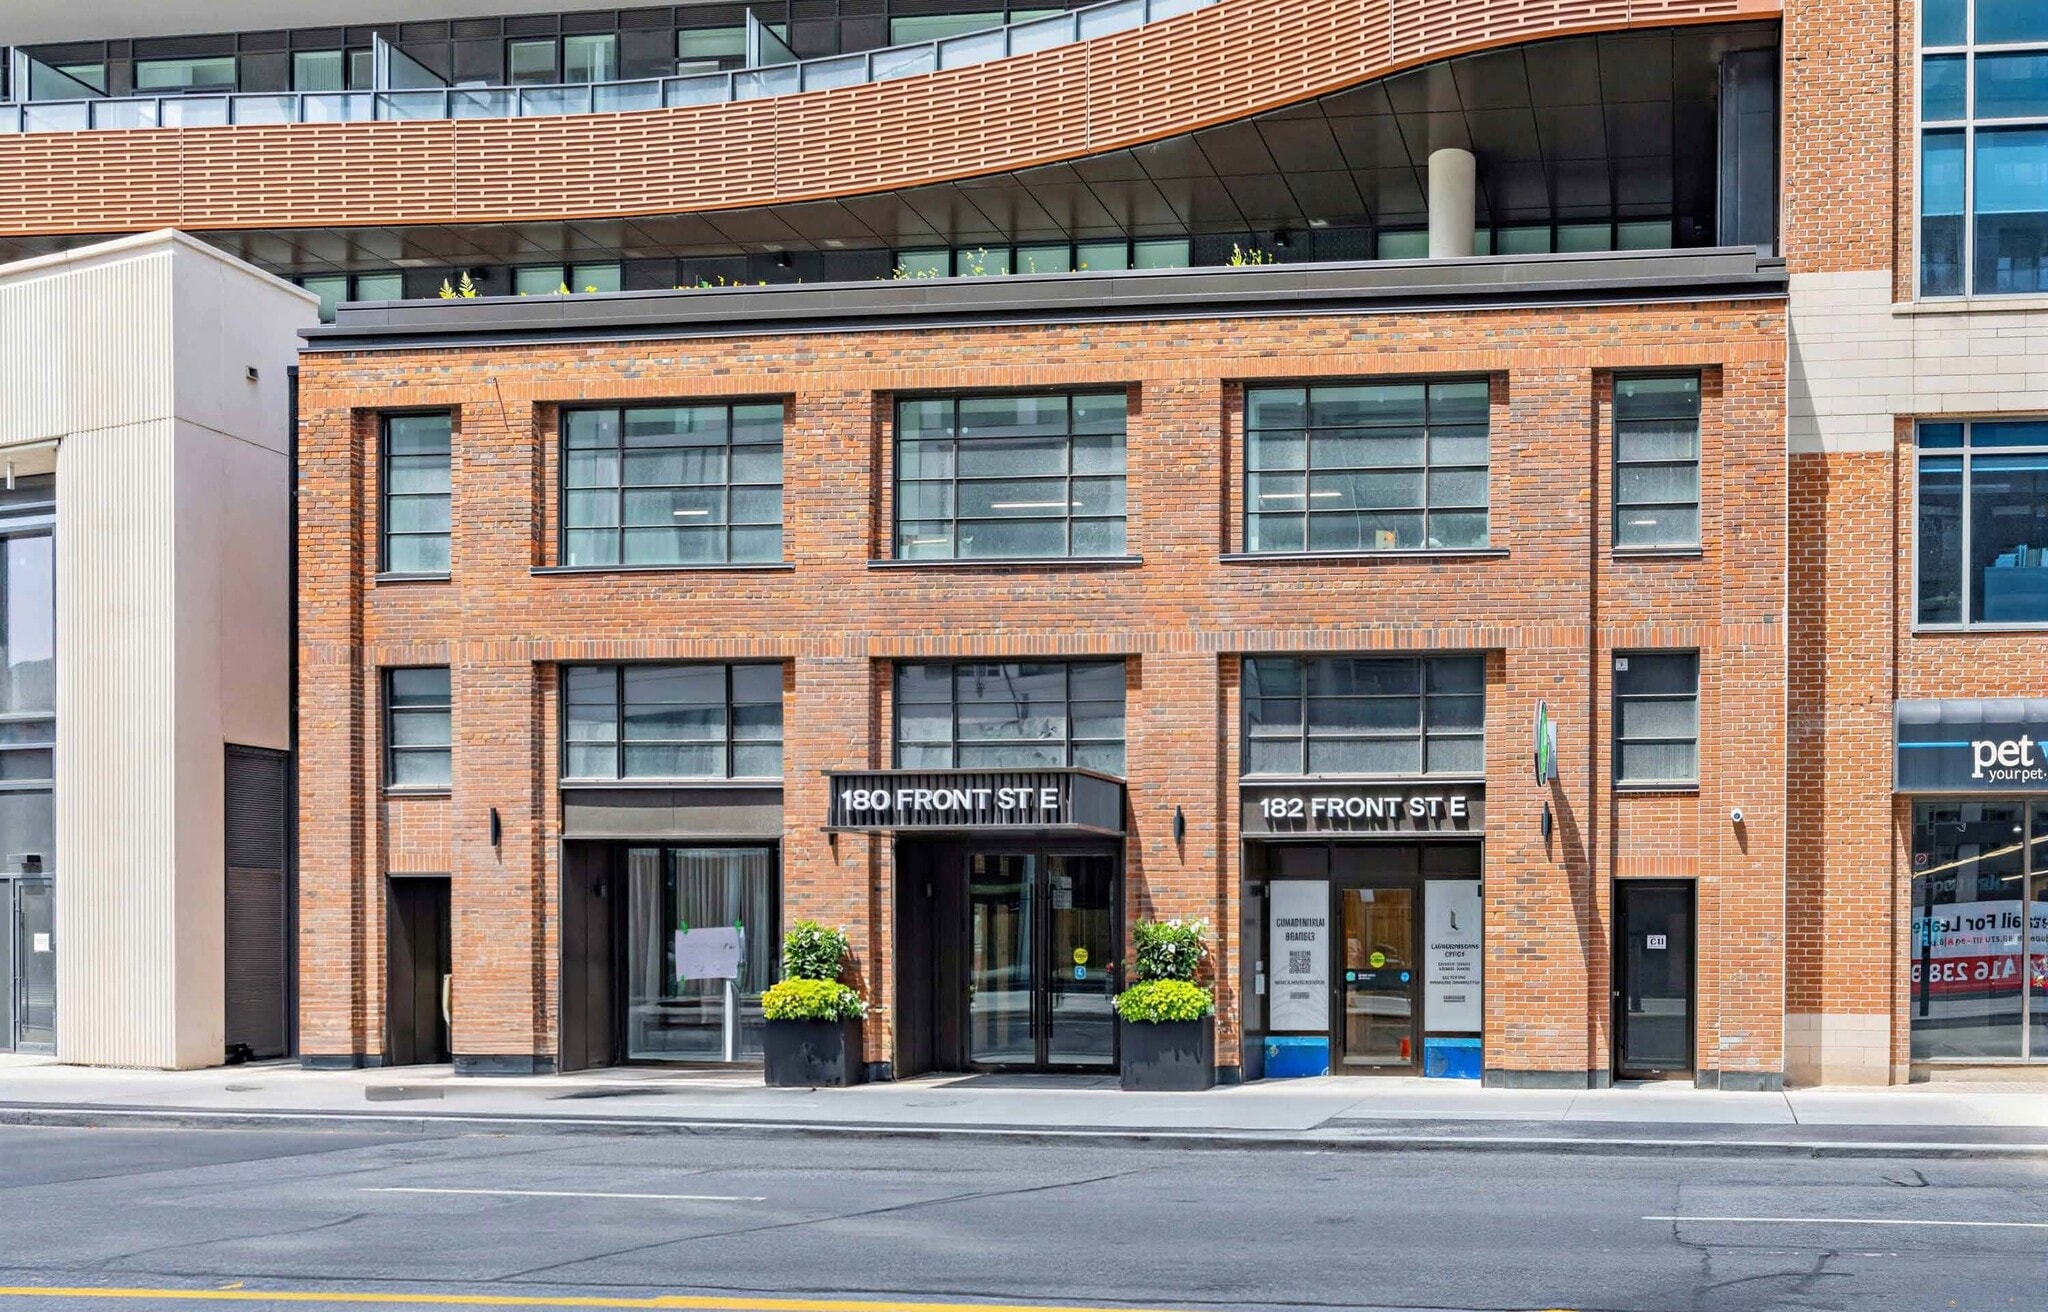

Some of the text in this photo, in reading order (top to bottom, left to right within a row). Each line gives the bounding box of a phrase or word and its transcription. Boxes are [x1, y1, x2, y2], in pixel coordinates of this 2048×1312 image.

[1972, 734, 2034, 778] pet
[841, 788, 1058, 811] 180 FRONT ST E
[1260, 796, 1466, 818] 182 FRONT ST E
